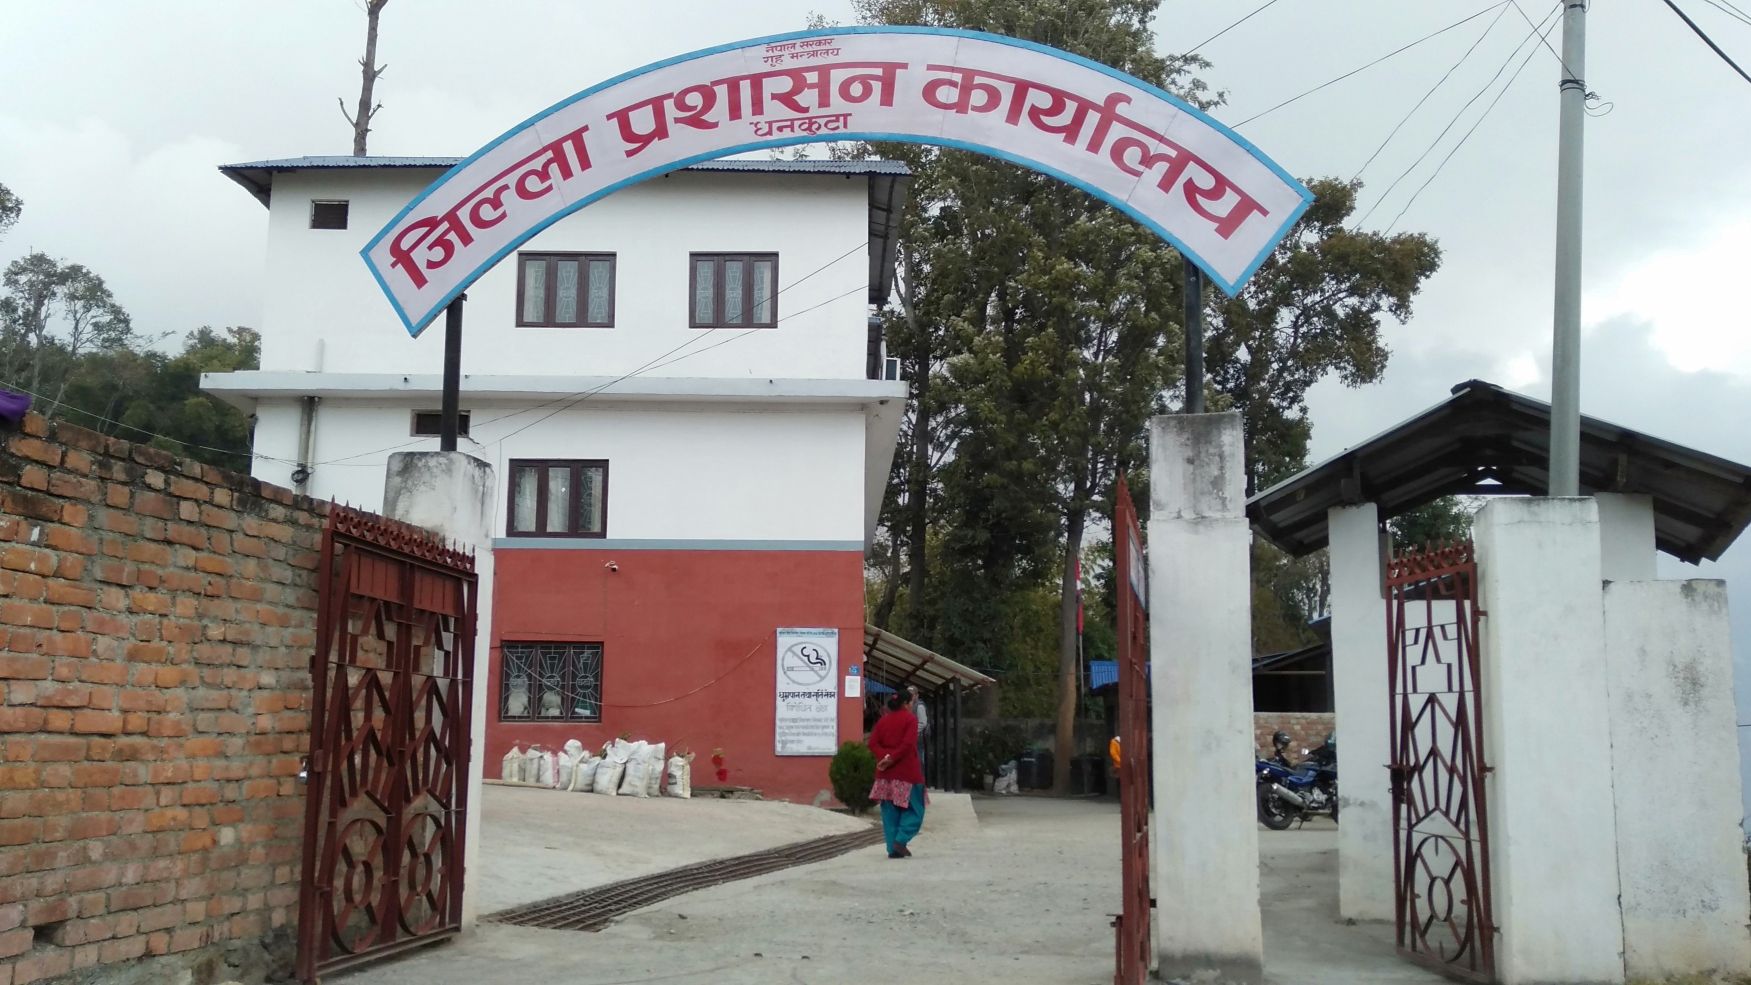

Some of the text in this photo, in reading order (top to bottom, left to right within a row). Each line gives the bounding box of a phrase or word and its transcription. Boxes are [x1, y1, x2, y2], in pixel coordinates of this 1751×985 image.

[766, 38, 835, 53] नेपाल सरकार
[763, 48, 842, 67] गृह मन्त्रालय
[750, 113, 852, 137] धनकुटा
[389, 61, 1271, 290] जिल्ला प्रशासन कार्यालय
